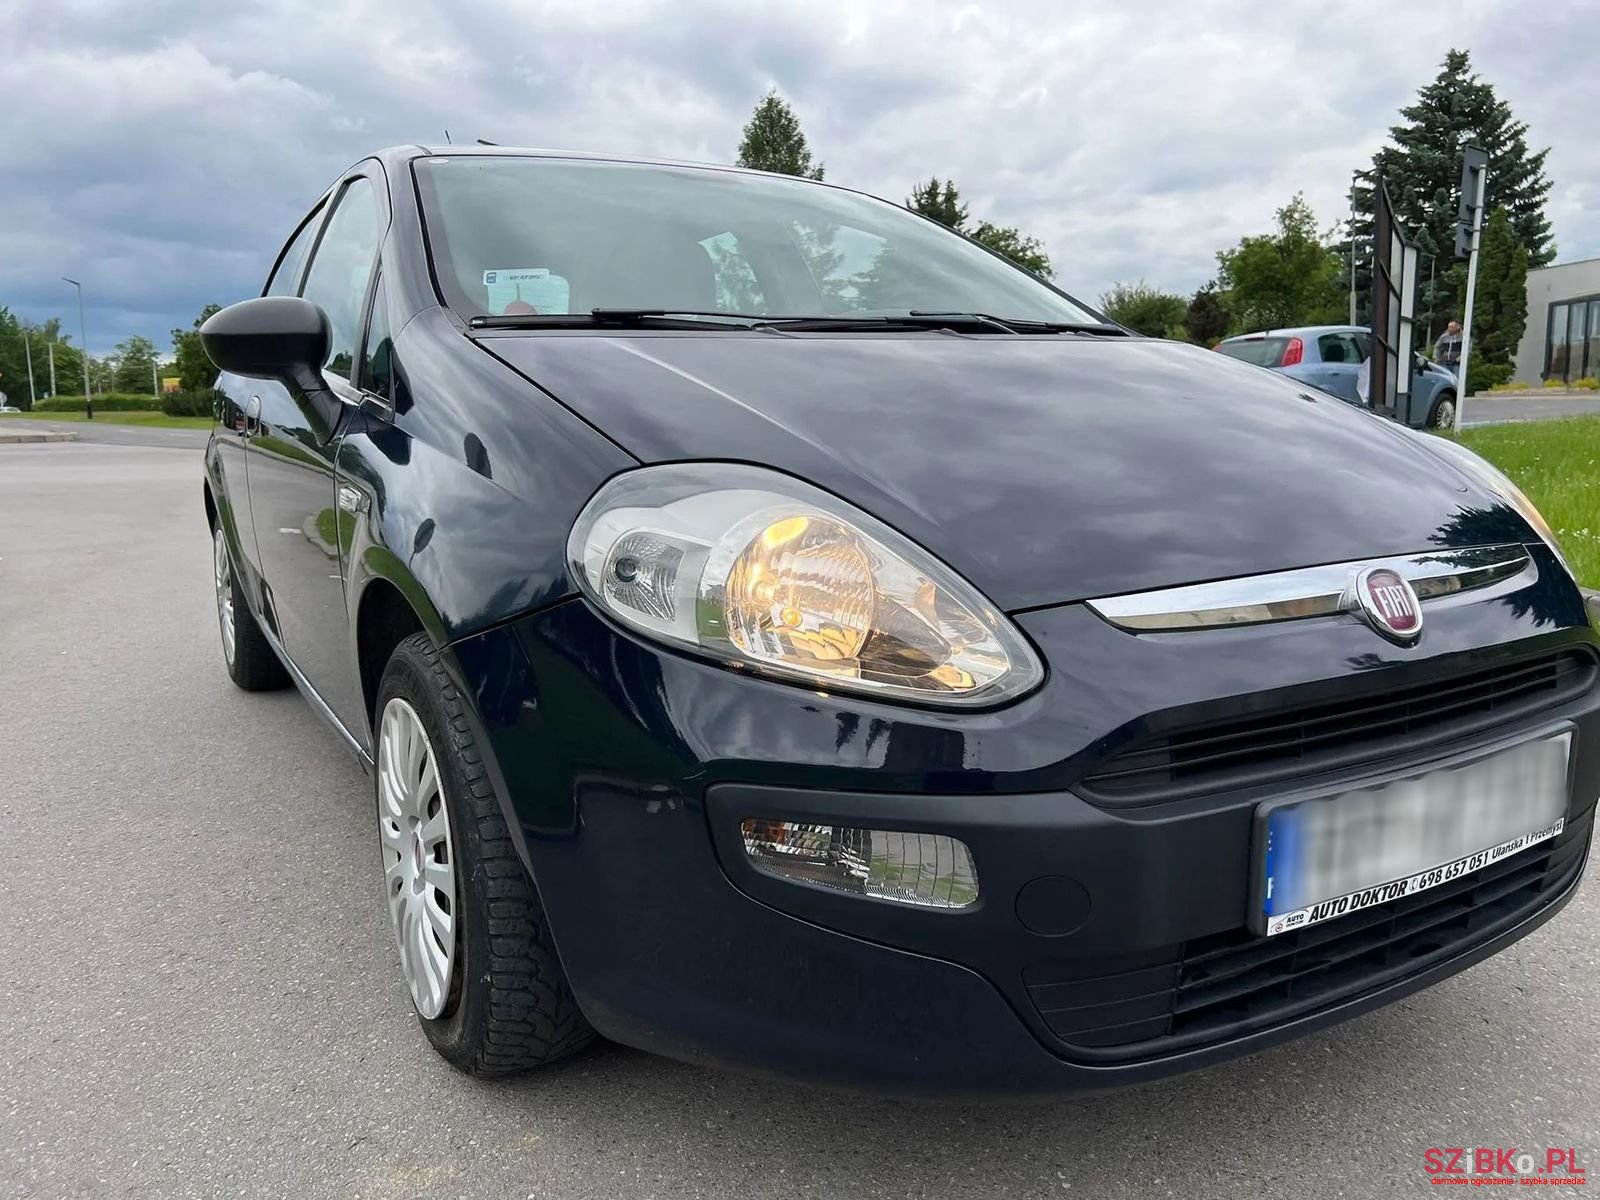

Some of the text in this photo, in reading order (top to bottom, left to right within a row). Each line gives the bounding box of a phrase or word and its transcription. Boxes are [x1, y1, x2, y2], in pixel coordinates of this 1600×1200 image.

[1374, 585, 1412, 618] FIAT
[1308, 896, 1349, 923] AUTO
[1349, 879, 1409, 910] DOKTOR
[1419, 868, 1443, 889] 698
[1445, 859, 1468, 880] 657
[1469, 851, 1489, 871] 051
[1286, 913, 1305, 923] AUTO
